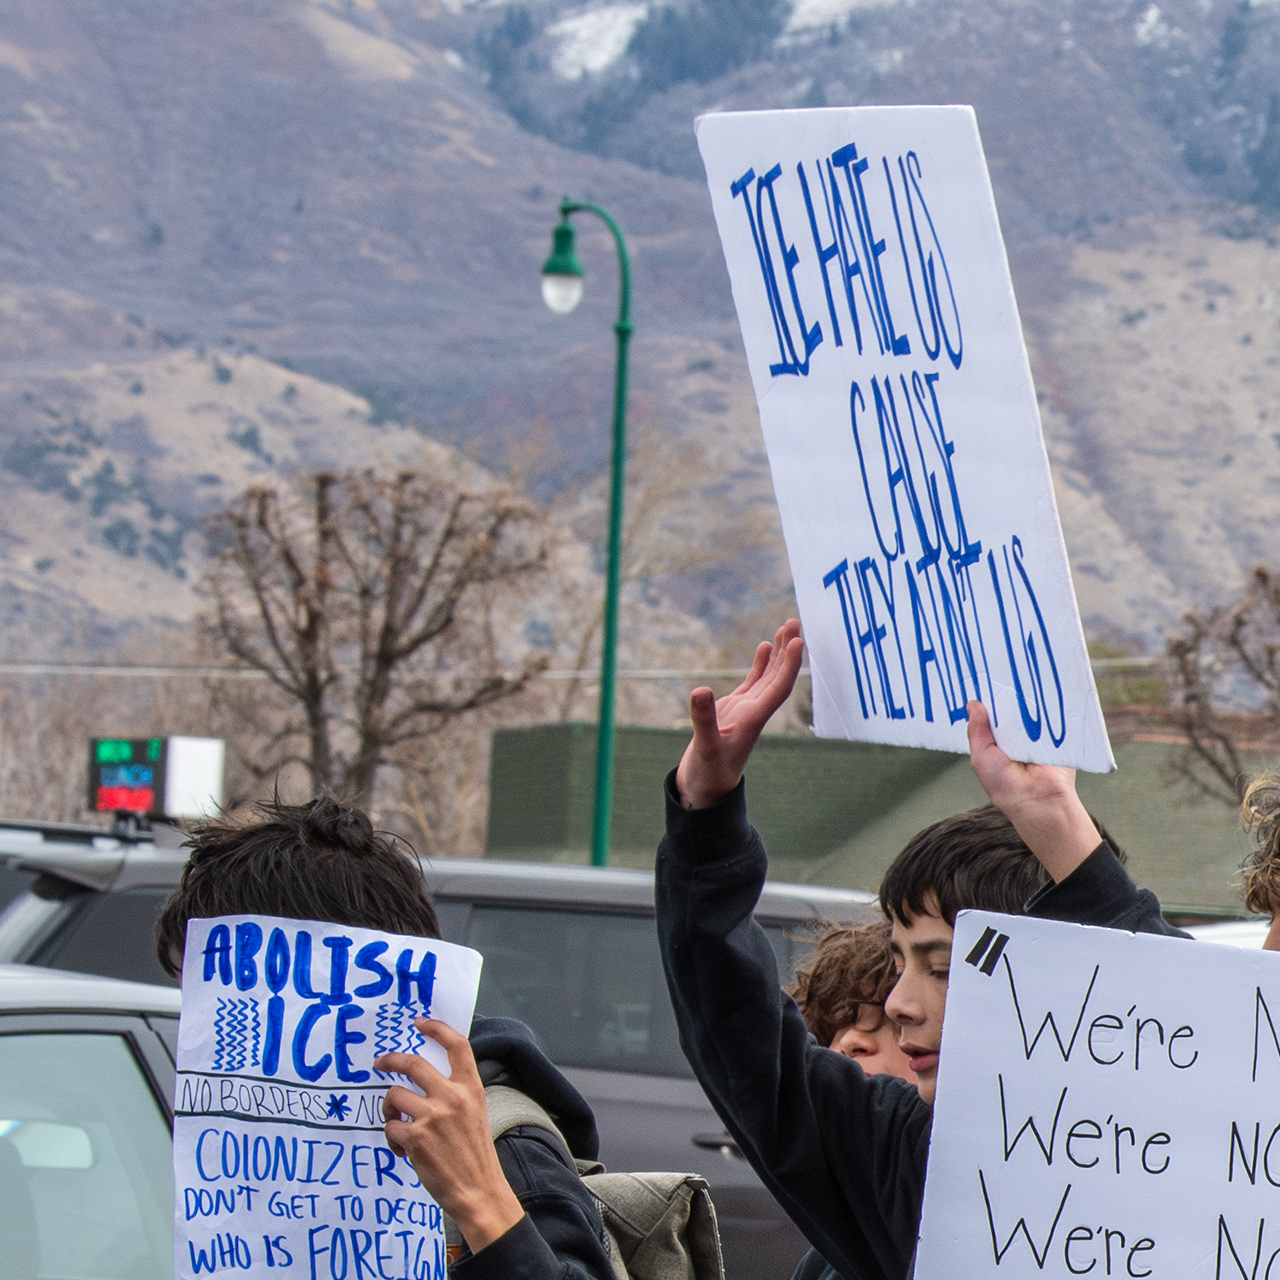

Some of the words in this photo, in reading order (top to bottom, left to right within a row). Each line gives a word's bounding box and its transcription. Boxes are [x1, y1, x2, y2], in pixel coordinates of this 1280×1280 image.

[730, 162, 824, 378] ICE
[796, 141, 912, 357] HATE
[881, 150, 963, 371] US
[849, 369, 982, 563] CAUSE
[822, 555, 915, 721] THEY
[987, 534, 1067, 749] US
[201, 921, 438, 1007] ABOLISH
[262, 994, 371, 1083] ICE
[181, 1078, 213, 1113] NO
[219, 1079, 329, 1121] BORDERS
[998, 1073, 1171, 1174] We're
[183, 1184, 260, 1222] DON'T
[267, 1191, 320, 1220] GET
[334, 1195, 364, 1221] TO
[375, 1197, 444, 1235] DECIDE
[188, 1232, 252, 1275] WHO
[262, 1235, 294, 1268] IS
[978, 1168, 1155, 1278] We're
